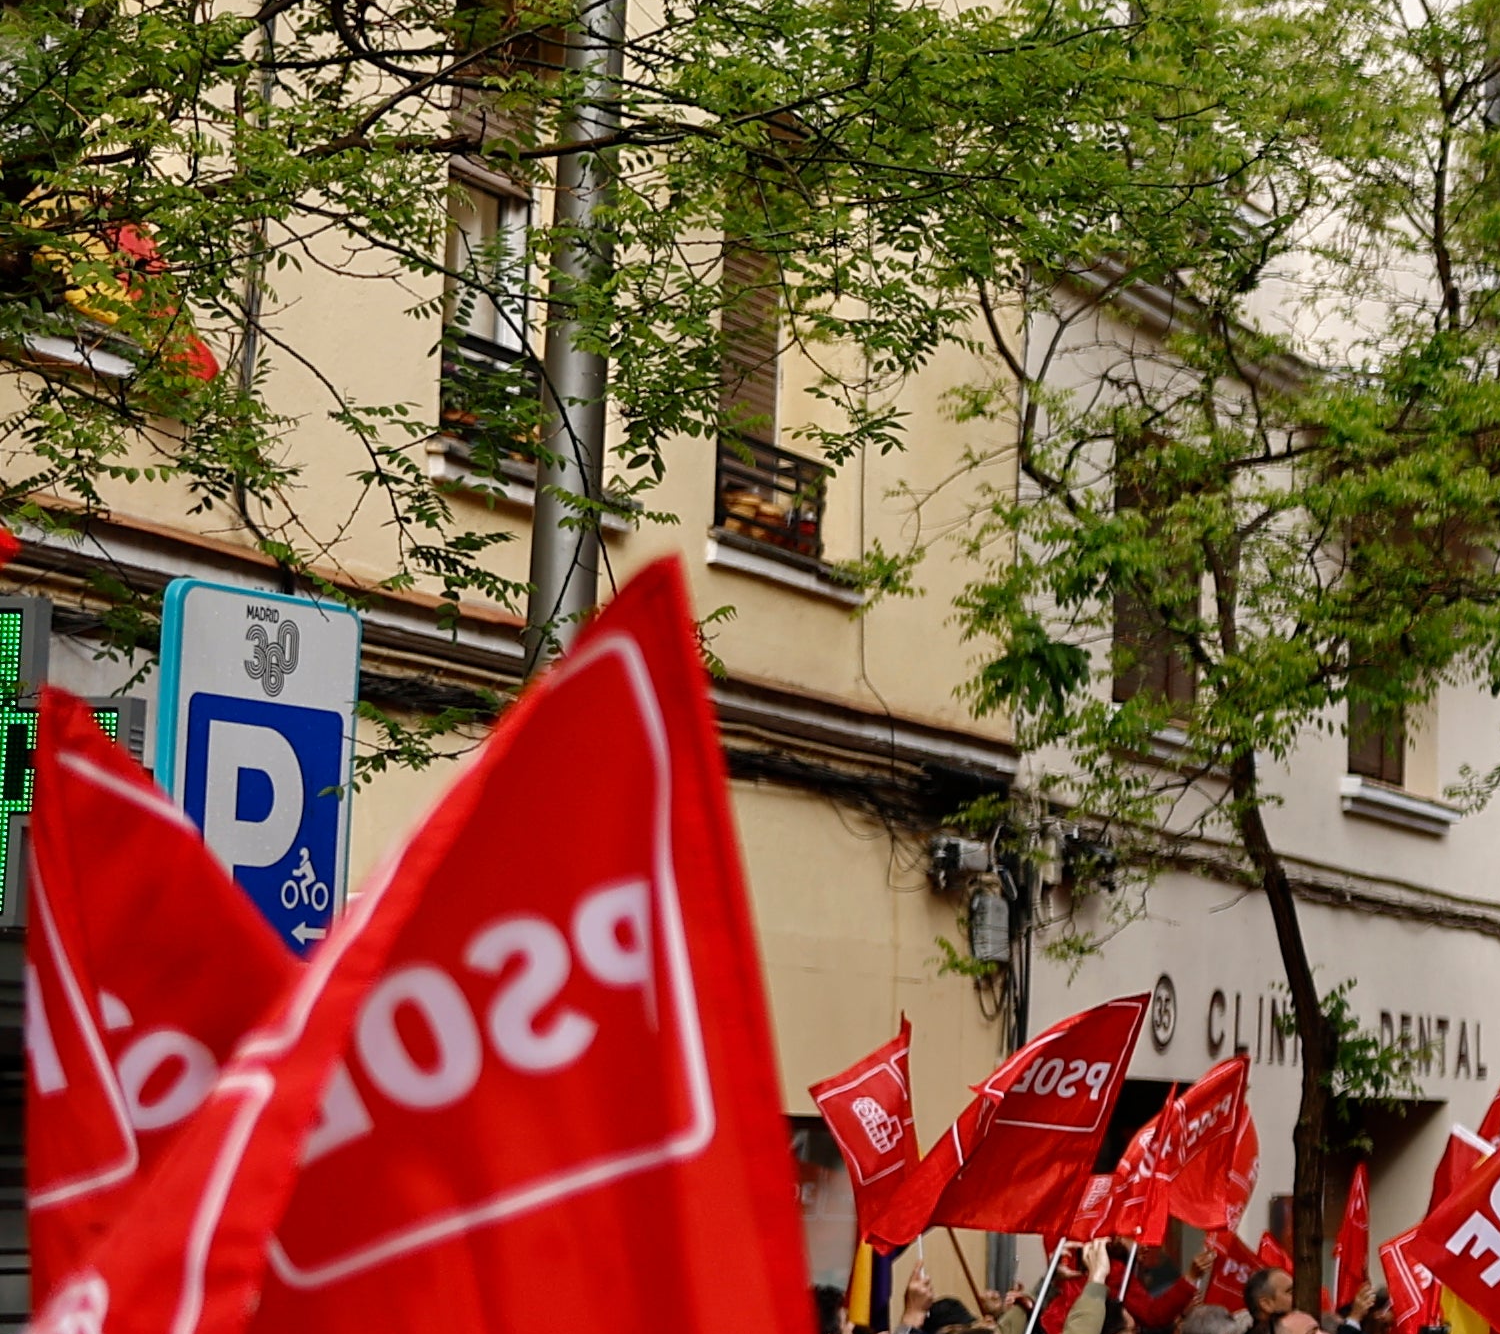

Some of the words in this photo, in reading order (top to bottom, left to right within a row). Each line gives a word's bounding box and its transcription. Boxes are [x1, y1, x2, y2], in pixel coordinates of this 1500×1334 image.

[247, 605, 279, 623] MADRID
[244, 620, 300, 697] 360
[203, 719, 304, 883] P
[1207, 989, 1300, 1067] CLINI
[1380, 1011, 1488, 1081] DENTAL
[1222, 1259, 1251, 1285] PS
